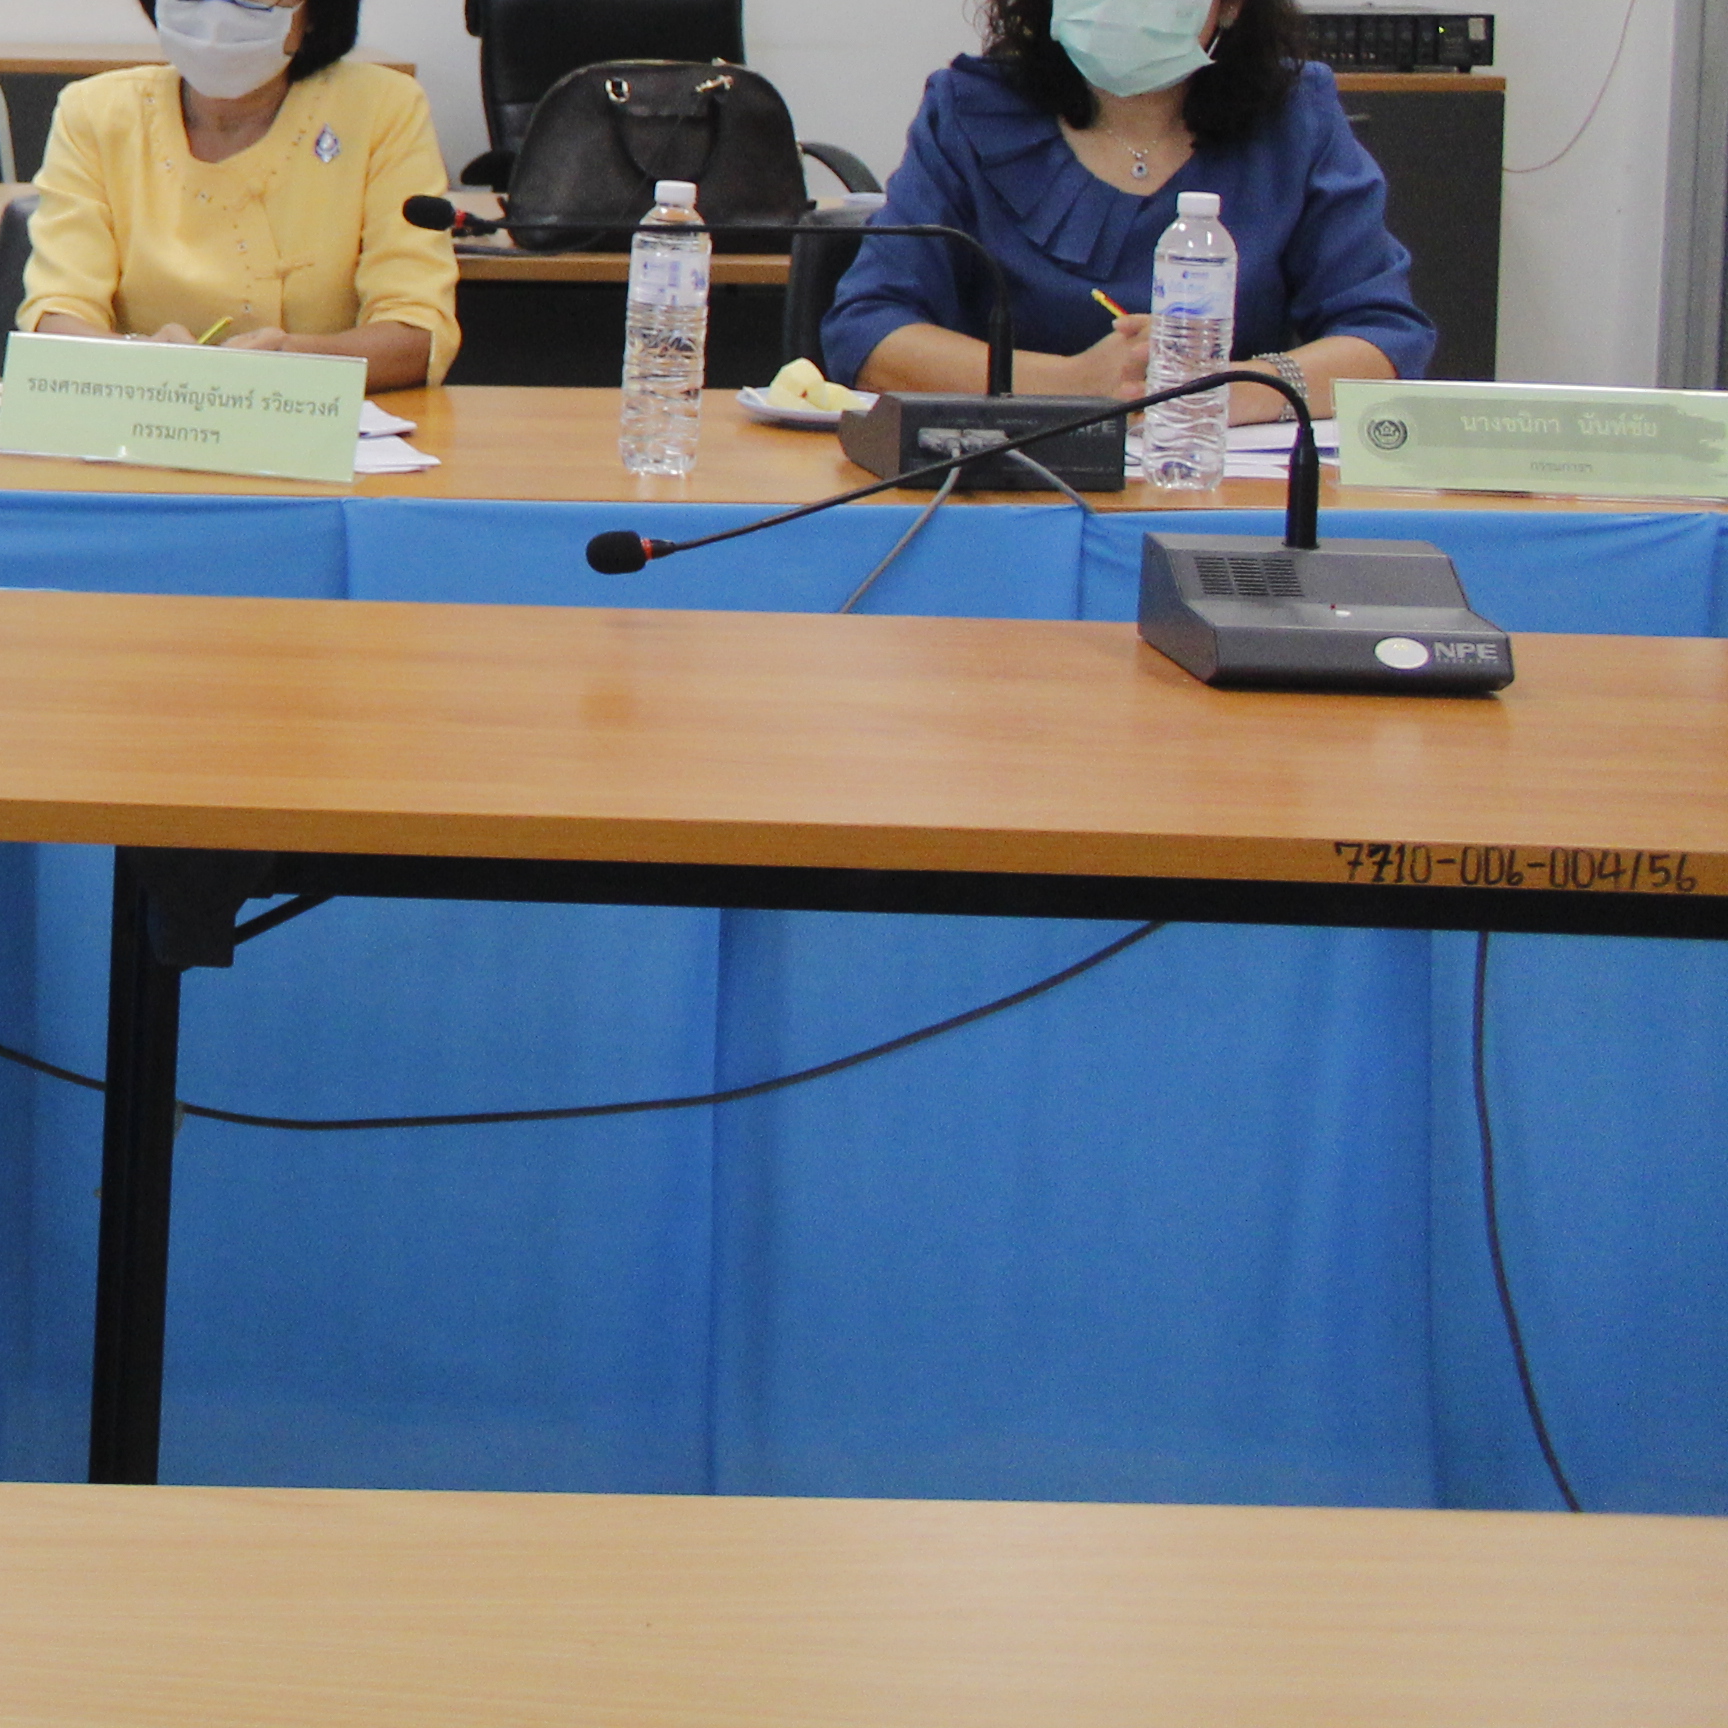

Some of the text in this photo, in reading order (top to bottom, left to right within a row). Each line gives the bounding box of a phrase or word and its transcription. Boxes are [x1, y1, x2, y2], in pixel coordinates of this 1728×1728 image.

[131, 422, 221, 444] กรรมการฯ
[1434, 641, 1499, 660] NPE
